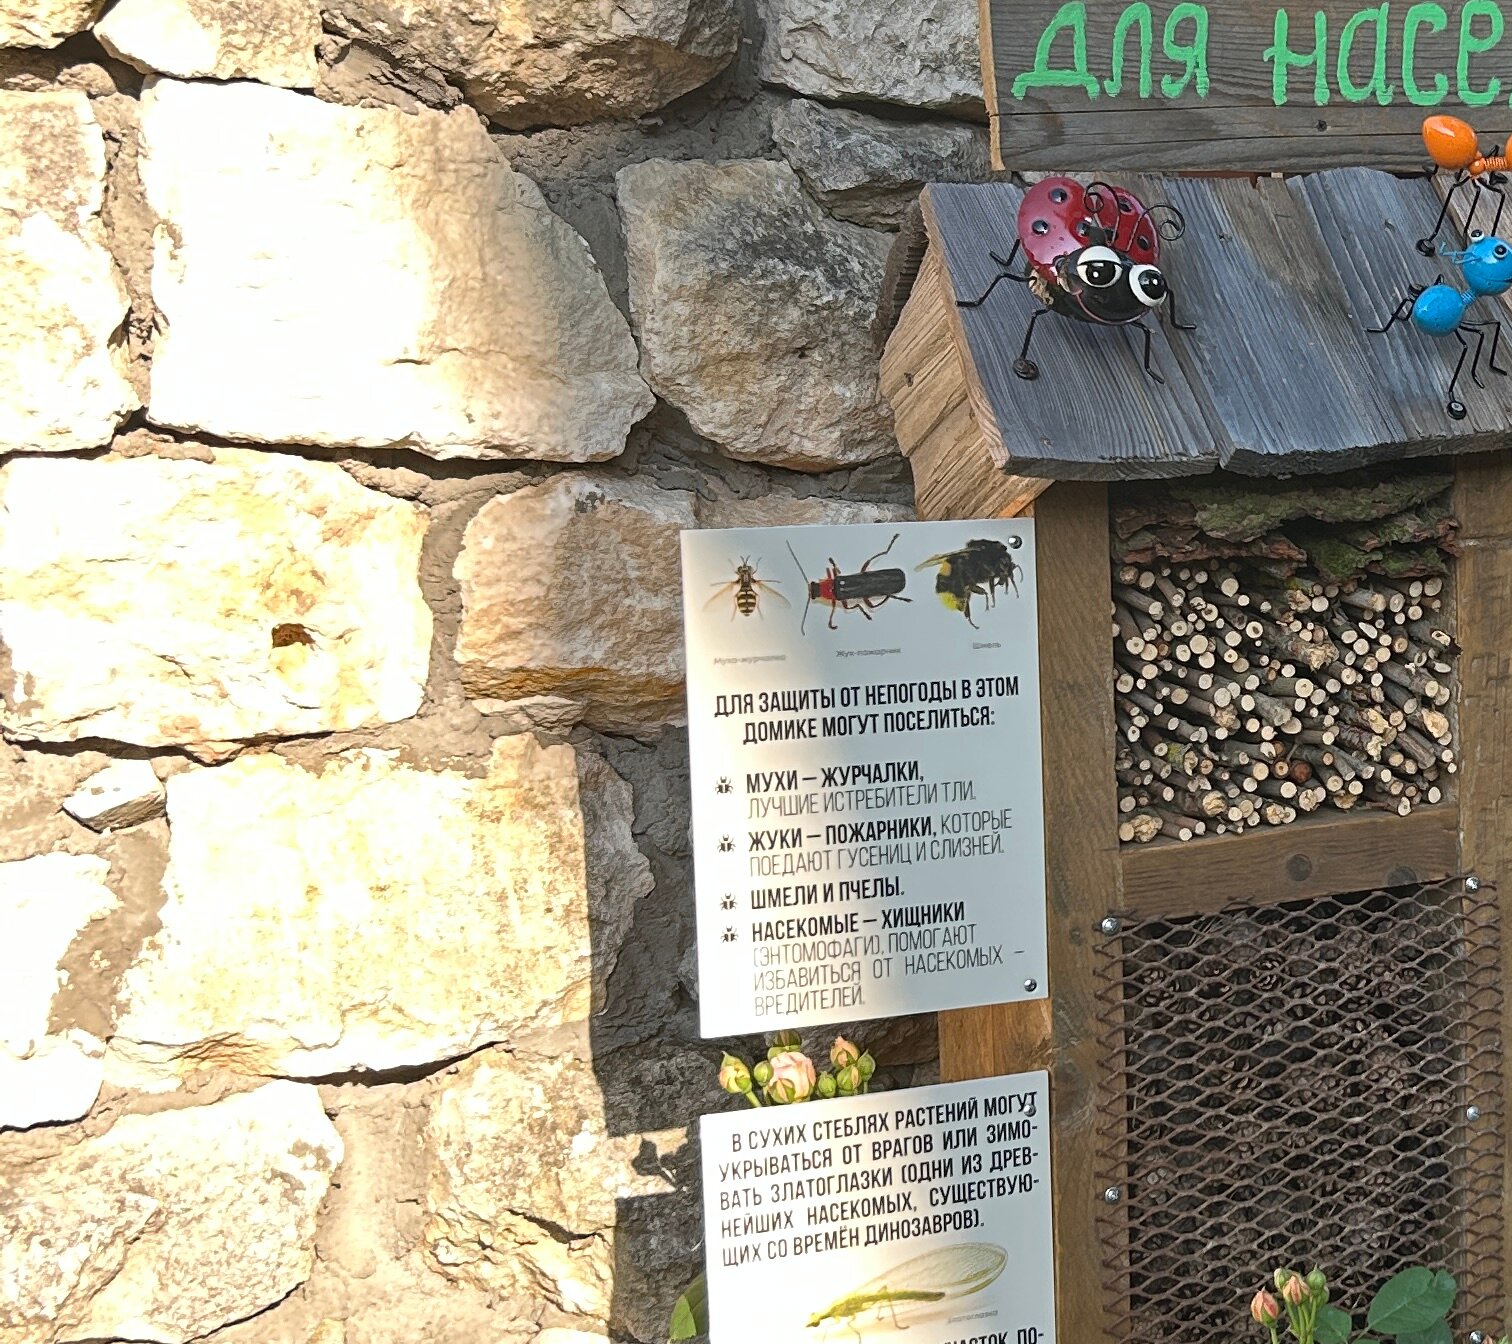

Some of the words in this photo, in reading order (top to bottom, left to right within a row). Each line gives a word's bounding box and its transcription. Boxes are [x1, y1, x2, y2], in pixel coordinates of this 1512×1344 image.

[714, 693, 754, 717] ДЛЯ
[759, 688, 835, 714] ЗАЩИТЫ
[840, 687, 860, 707] ОТ
[865, 680, 956, 706] НЕПОГОДЫ
[962, 679, 971, 698] В
[976, 676, 1019, 698] ЭТОМ
[743, 718, 817, 745] ДОМИКЕ
[822, 714, 878, 737] МОГУТ
[883, 706, 995, 732] ПОСЕЛИТЬСЯ:
[746, 771, 798, 793] МУХИ
[821, 761, 924, 788] ЖУРЧАЛКИ,
[749, 793, 818, 818] ЛУЧШИЕ
[824, 783, 937, 812] ИСТРЕБИТЕЛИ
[941, 781, 976, 802] ТЛИ.
[749, 829, 802, 851] ЖУКИ
[826, 817, 936, 845] ПОЖАРНИКИ,
[941, 809, 1012, 834] КОТОРЫЕ
[750, 851, 831, 877] ПОЕДАЮТ
[837, 844, 912, 868] ГУСЕНИЦ
[917, 844, 925, 861] И
[931, 834, 1004, 860] СЛИЗНЕЙ.
[751, 884, 817, 909] ШМЕЛИ
[823, 883, 833, 902] И
[839, 876, 904, 901] ПЧЕЛЫ.
[752, 913, 858, 942] НАСЕКОМЫЕ
[882, 902, 964, 929] ХИЩНИКИ
[889, 924, 976, 952] ПОМОГАЮТ
[754, 961, 861, 991] ИЗБАВИТЬСЯ
[873, 958, 893, 978] ОТ
[905, 945, 1003, 975] НАСЕКОМЫХ
[756, 984, 865, 1016] ВРЕДИТЕЛЕЙ.
[732, 1134, 741, 1152] В
[749, 1124, 806, 1149] СУХИХ
[813, 1112, 889, 1141] СТЕБЛЯХ
[896, 1097, 978, 1130] РАСТЕНИЙ
[719, 1148, 832, 1182] УКРЫВАТЬСЯ
[842, 1144, 861, 1164] ОТ
[872, 1134, 933, 1160] ВРАГОВ
[943, 1129, 978, 1151] ИЛИ
[987, 1120, 1037, 1144] ЗИМО-
[721, 1186, 762, 1210] ВАТЬ
[771, 1167, 893, 1203] ЗЛАТОГЛАЗКИ
[902, 1159, 953, 1184] (ОДНИ
[961, 1154, 982, 1174] ИЗ
[989, 1147, 1038, 1173] ДРЕВ-
[722, 1208, 793, 1238] НЕЙШИХ
[807, 1192, 917, 1225] НАСЕКОМЫХ,
[930, 1174, 1039, 1207] СУЩЕСТВУЮ-
[723, 1244, 762, 1267] ЩИХ
[768, 1239, 787, 1259] СО
[793, 1224, 859, 1255] ВРЕМЁН
